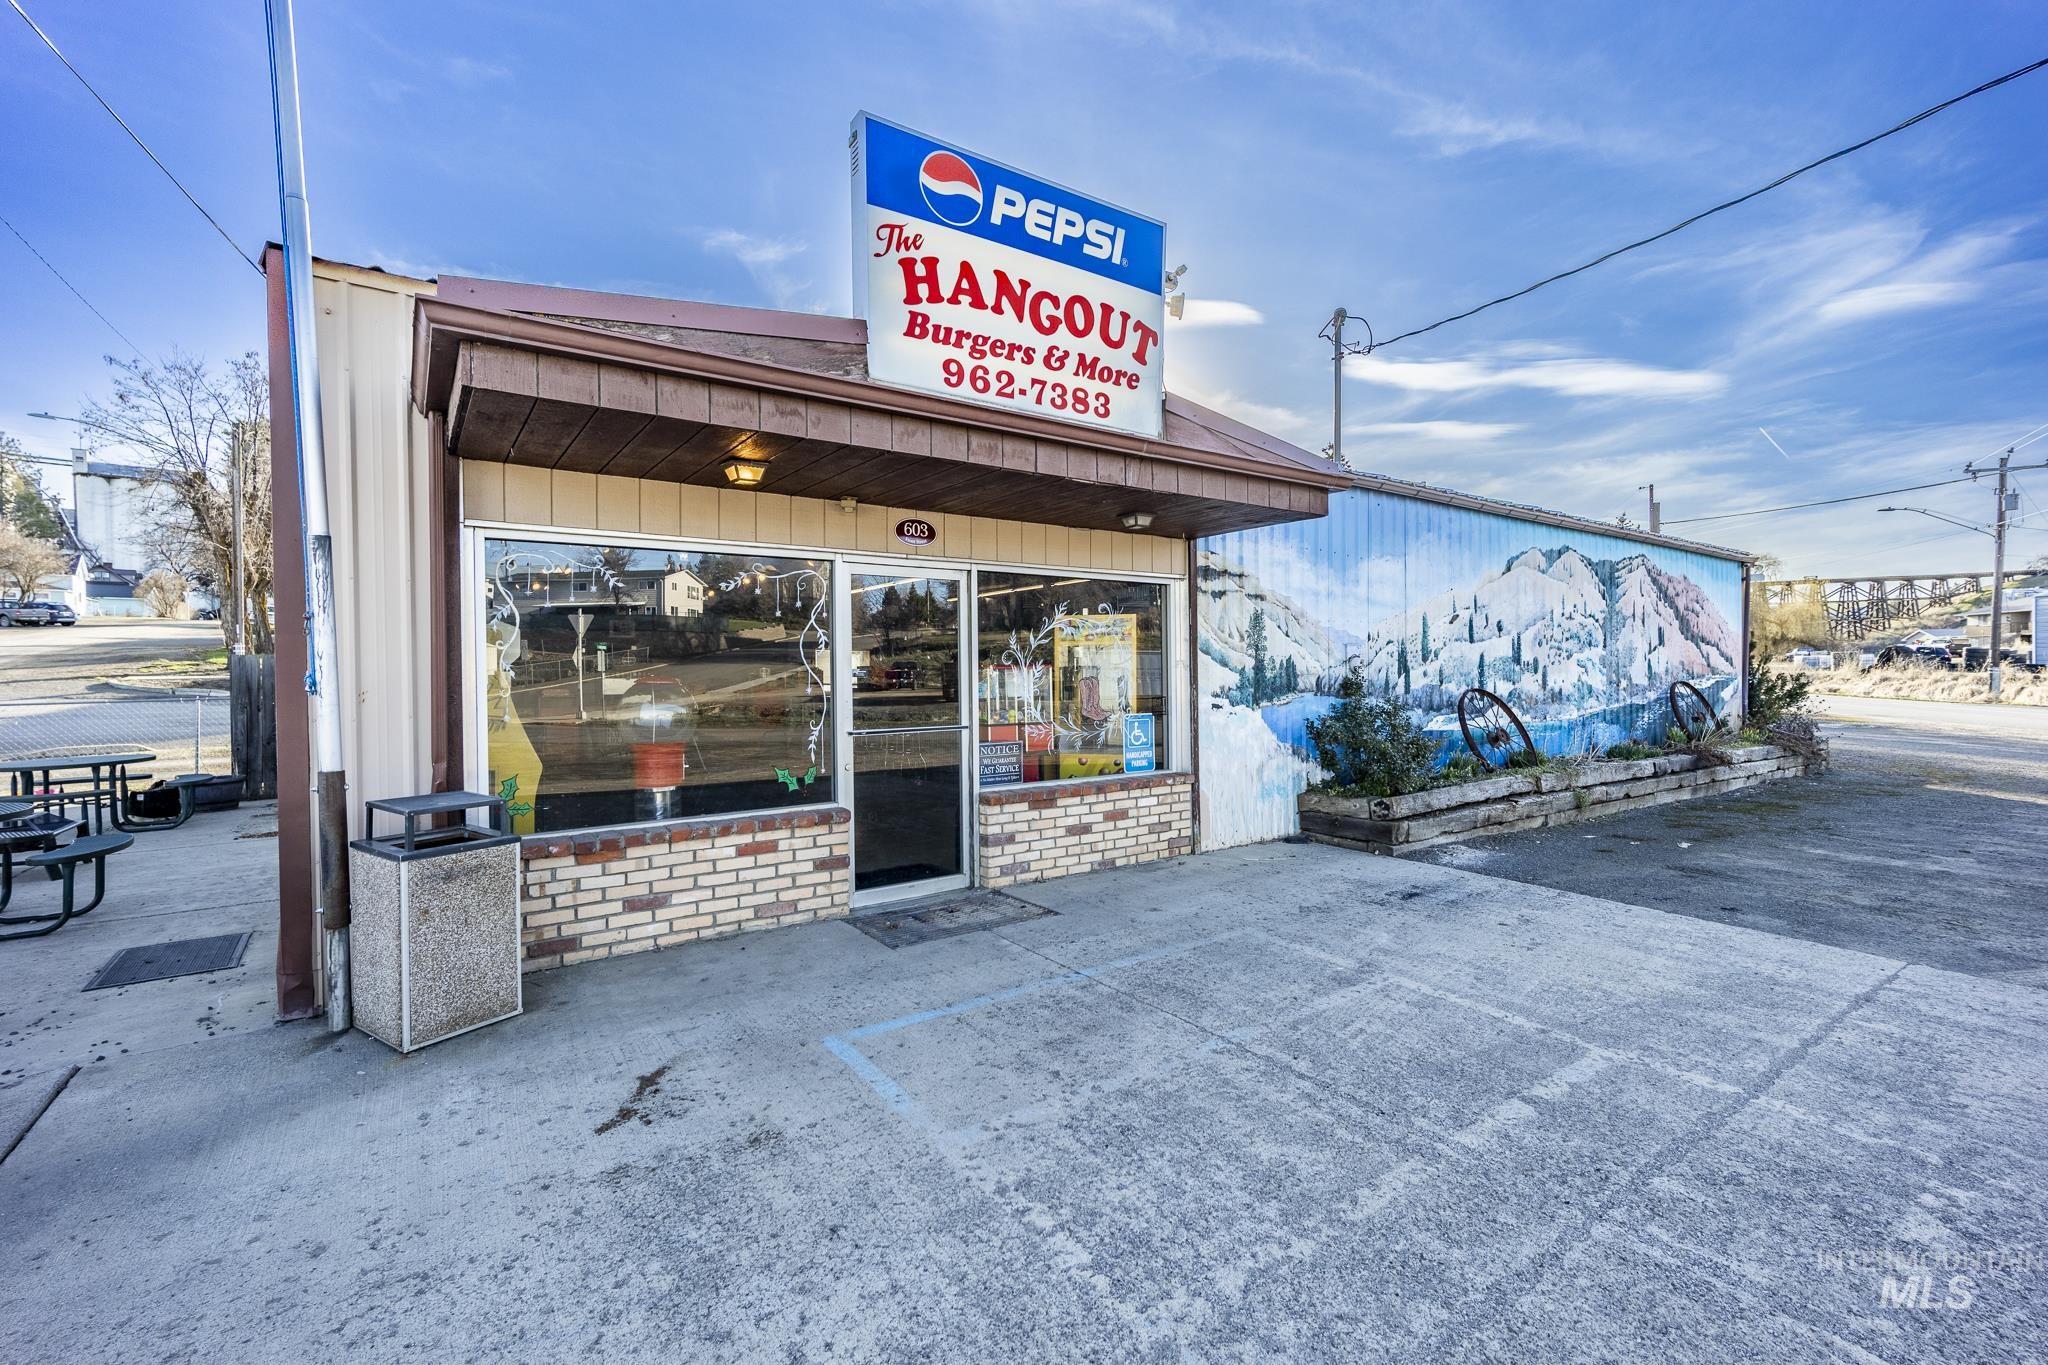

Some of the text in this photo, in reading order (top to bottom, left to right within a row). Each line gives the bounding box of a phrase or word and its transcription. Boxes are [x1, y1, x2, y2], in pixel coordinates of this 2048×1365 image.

[874, 222, 925, 257] The
[990, 184, 1126, 266] PEPSI
[898, 256, 1159, 366] HANGOUT
[903, 310, 1141, 390] Burgers & More
[942, 358, 1111, 419] 962-7383
[904, 522, 928, 537] 603
[980, 745, 1019, 755] NOTICE
[1131, 759, 1148, 767] PARKING
[980, 764, 1019, 774] FAST SERVICE
